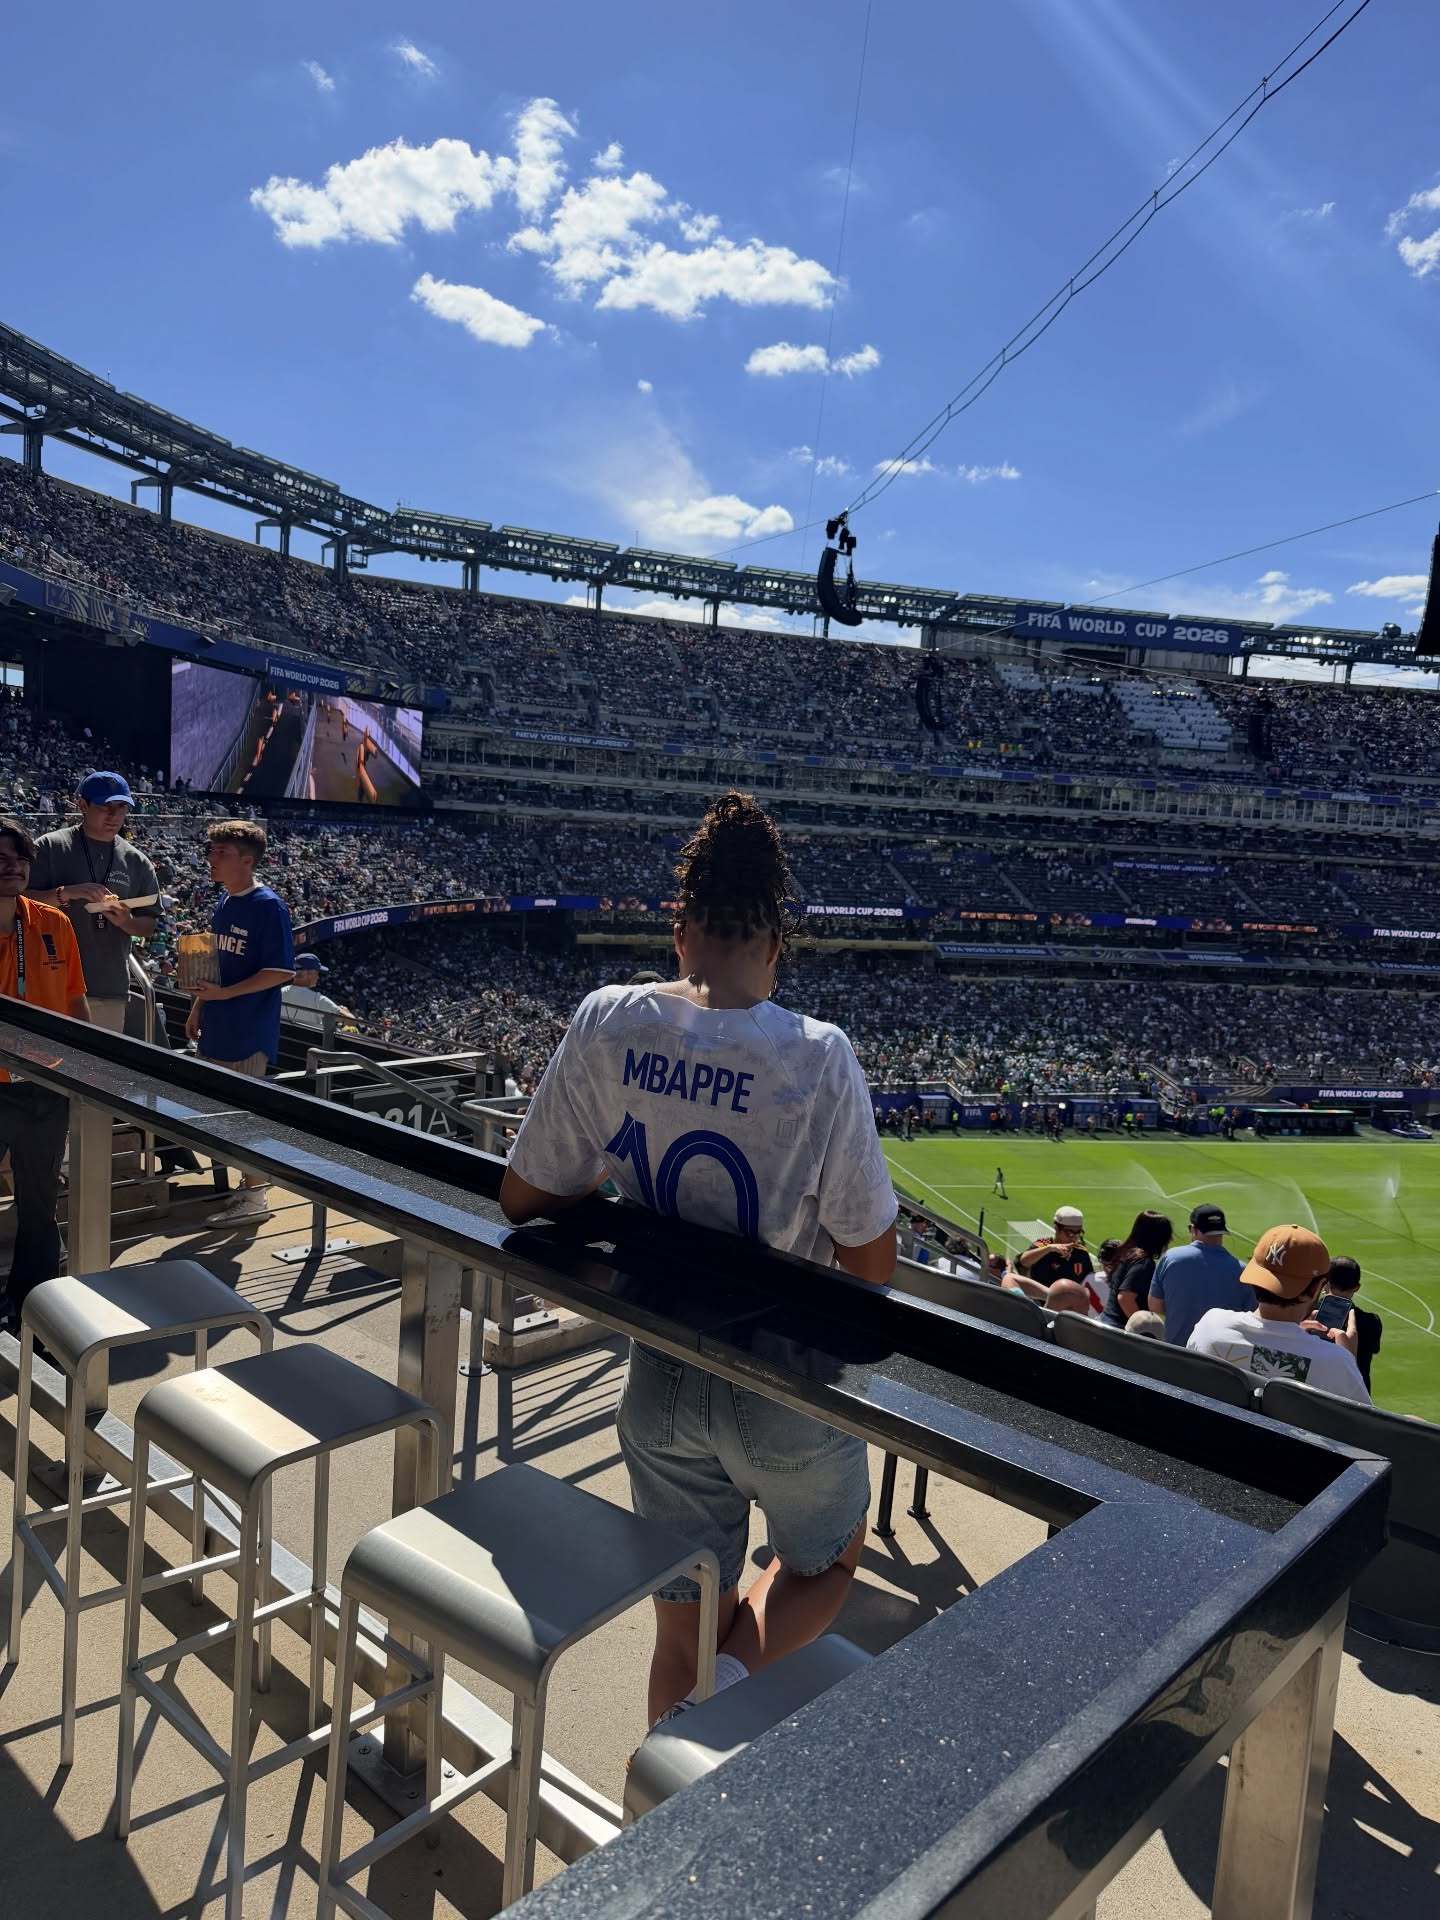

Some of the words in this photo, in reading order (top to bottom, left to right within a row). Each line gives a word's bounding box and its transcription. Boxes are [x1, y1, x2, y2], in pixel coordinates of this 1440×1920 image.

[1028, 612, 1061, 629] FIFA
[1068, 616, 1126, 635] WORLD
[1135, 623, 1167, 638] CUP
[1173, 626, 1229, 643] 2026
[270, 665, 284, 677] FIFA
[284, 670, 307, 682] WORLD
[307, 675, 319, 685] CUP
[320, 678, 339, 690] 2026
[515, 731, 538, 739] NEW
[540, 733, 566, 742] YORK
[592, 739, 630, 748] JERSEY
[807, 905, 825, 914] FIFA
[826, 906, 856, 915] WORLD
[857, 907, 873, 915] CUP
[874, 908, 903, 917] 2026
[334, 919, 345, 933] FIFA
[345, 916, 361, 931] WORLD
[361, 914, 370, 927] CUP
[370, 911, 389, 924] 2026
[215, 934, 247, 955] NCE
[1391, 930, 1420, 938] WORLD
[1420, 931, 1436, 939] CUP
[623, 1048, 754, 1113] MBAPPE
[1318, 1089, 1335, 1098] FIFA
[1336, 1090, 1361, 1098] WORLD
[1362, 1090, 1377, 1098] CUP
[1378, 1091, 1404, 1099] 2026
[964, 1108, 982, 1117] FIFA
[604, 1112, 760, 1240] 10
[1265, 1242, 1287, 1266] NY
